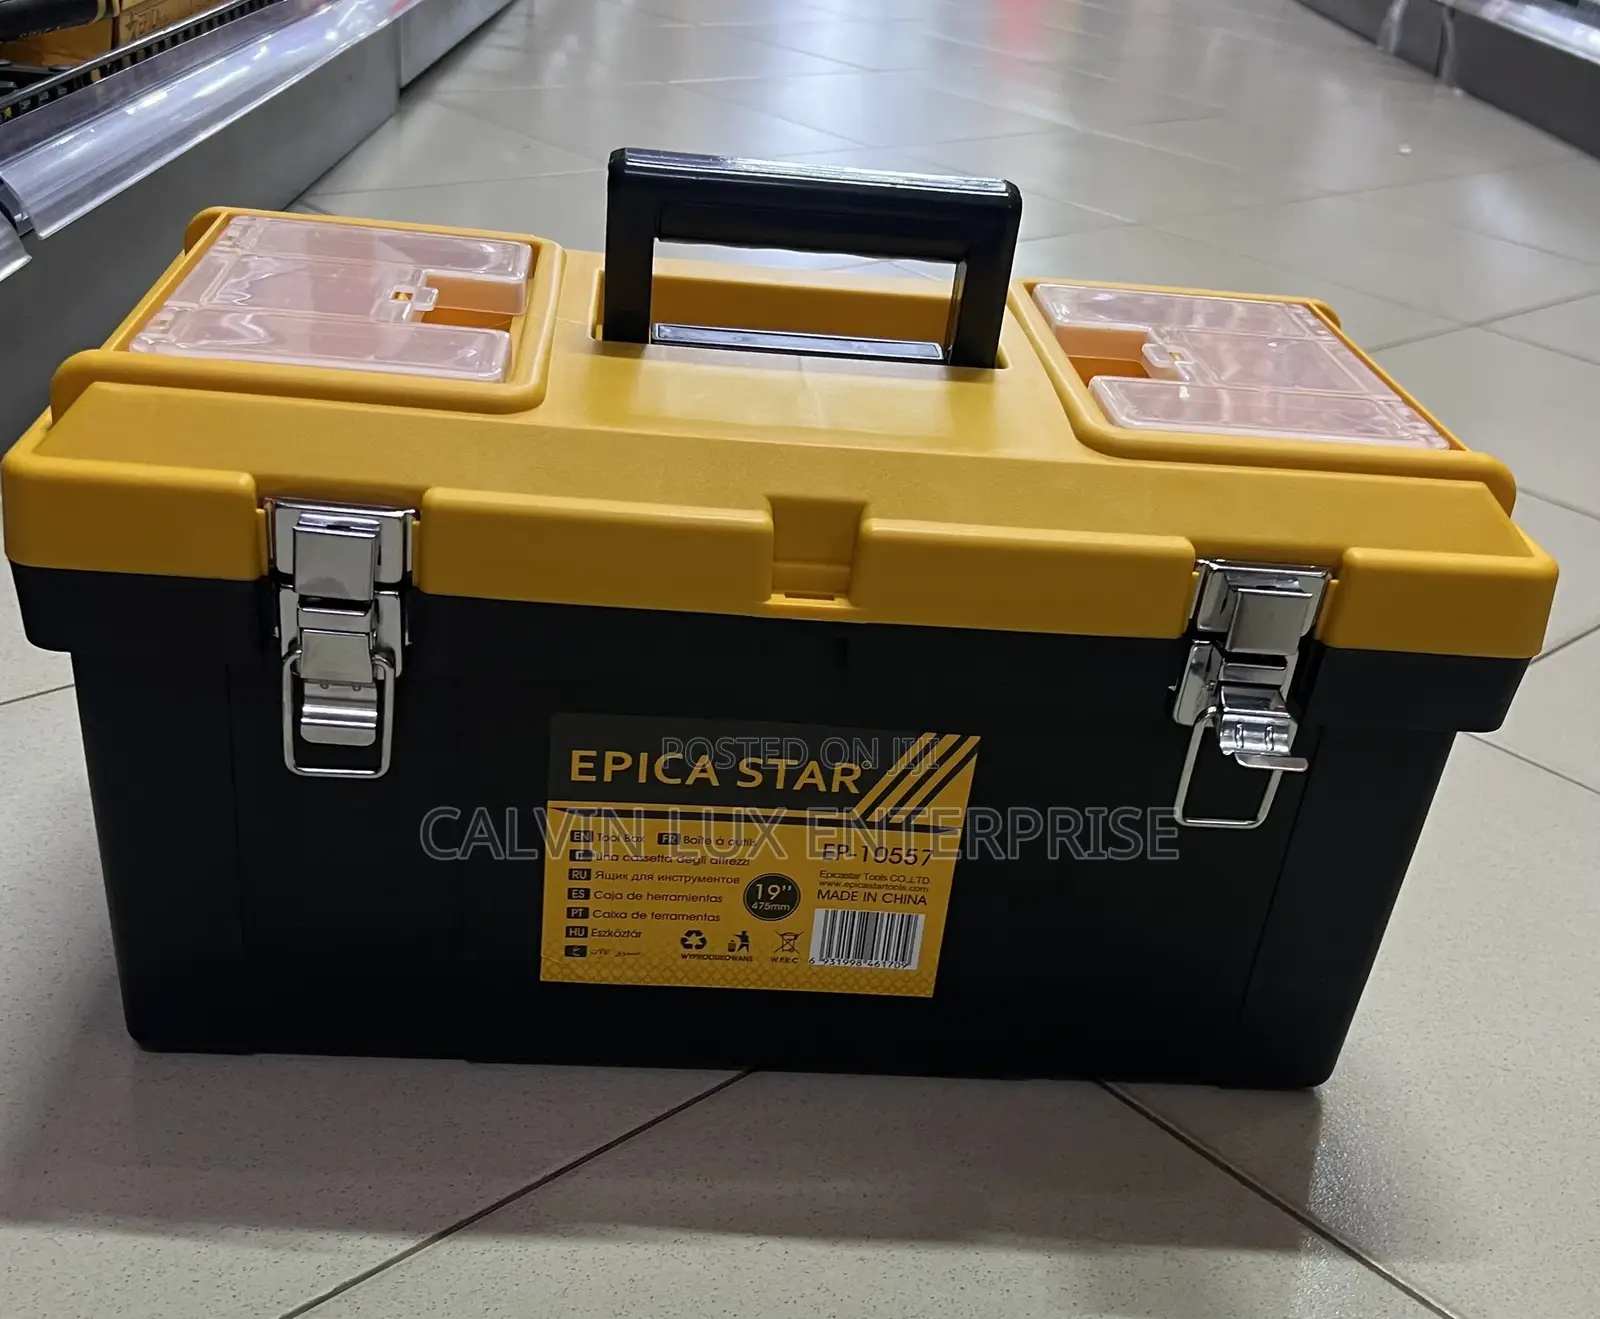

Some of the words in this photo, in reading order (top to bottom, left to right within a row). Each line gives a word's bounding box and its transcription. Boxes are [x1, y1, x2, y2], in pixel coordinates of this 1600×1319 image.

[570, 749, 720, 786] EPICA
[573, 832, 588, 842] EN
[624, 833, 645, 843] Box
[661, 834, 677, 844] FR
[728, 838, 757, 848] outils
[622, 854, 672, 864] cassetta
[677, 855, 707, 867] degli
[822, 843, 935, 867] EP-10557
[571, 870, 588, 880] RU
[595, 871, 628, 882] Ящик
[631, 872, 655, 882] для
[657, 874, 741, 885] инструментов
[864, 872, 887, 882] Tools
[571, 889, 585, 899] ES
[593, 890, 623, 902] Caja
[626, 890, 643, 901] de
[646, 891, 724, 904] herramientas
[816, 889, 859, 902] MADE
[863, 891, 878, 903] IN
[882, 893, 928, 906] CHINA
[570, 908, 584, 918] PT
[592, 909, 628, 920] Caixa
[631, 910, 648, 920] de
[651, 911, 721, 922] ferramentas
[569, 928, 586, 938] HU
[808, 957, 816, 965] 6
[822, 958, 863, 967] 931998
[867, 960, 909, 970] 461709
